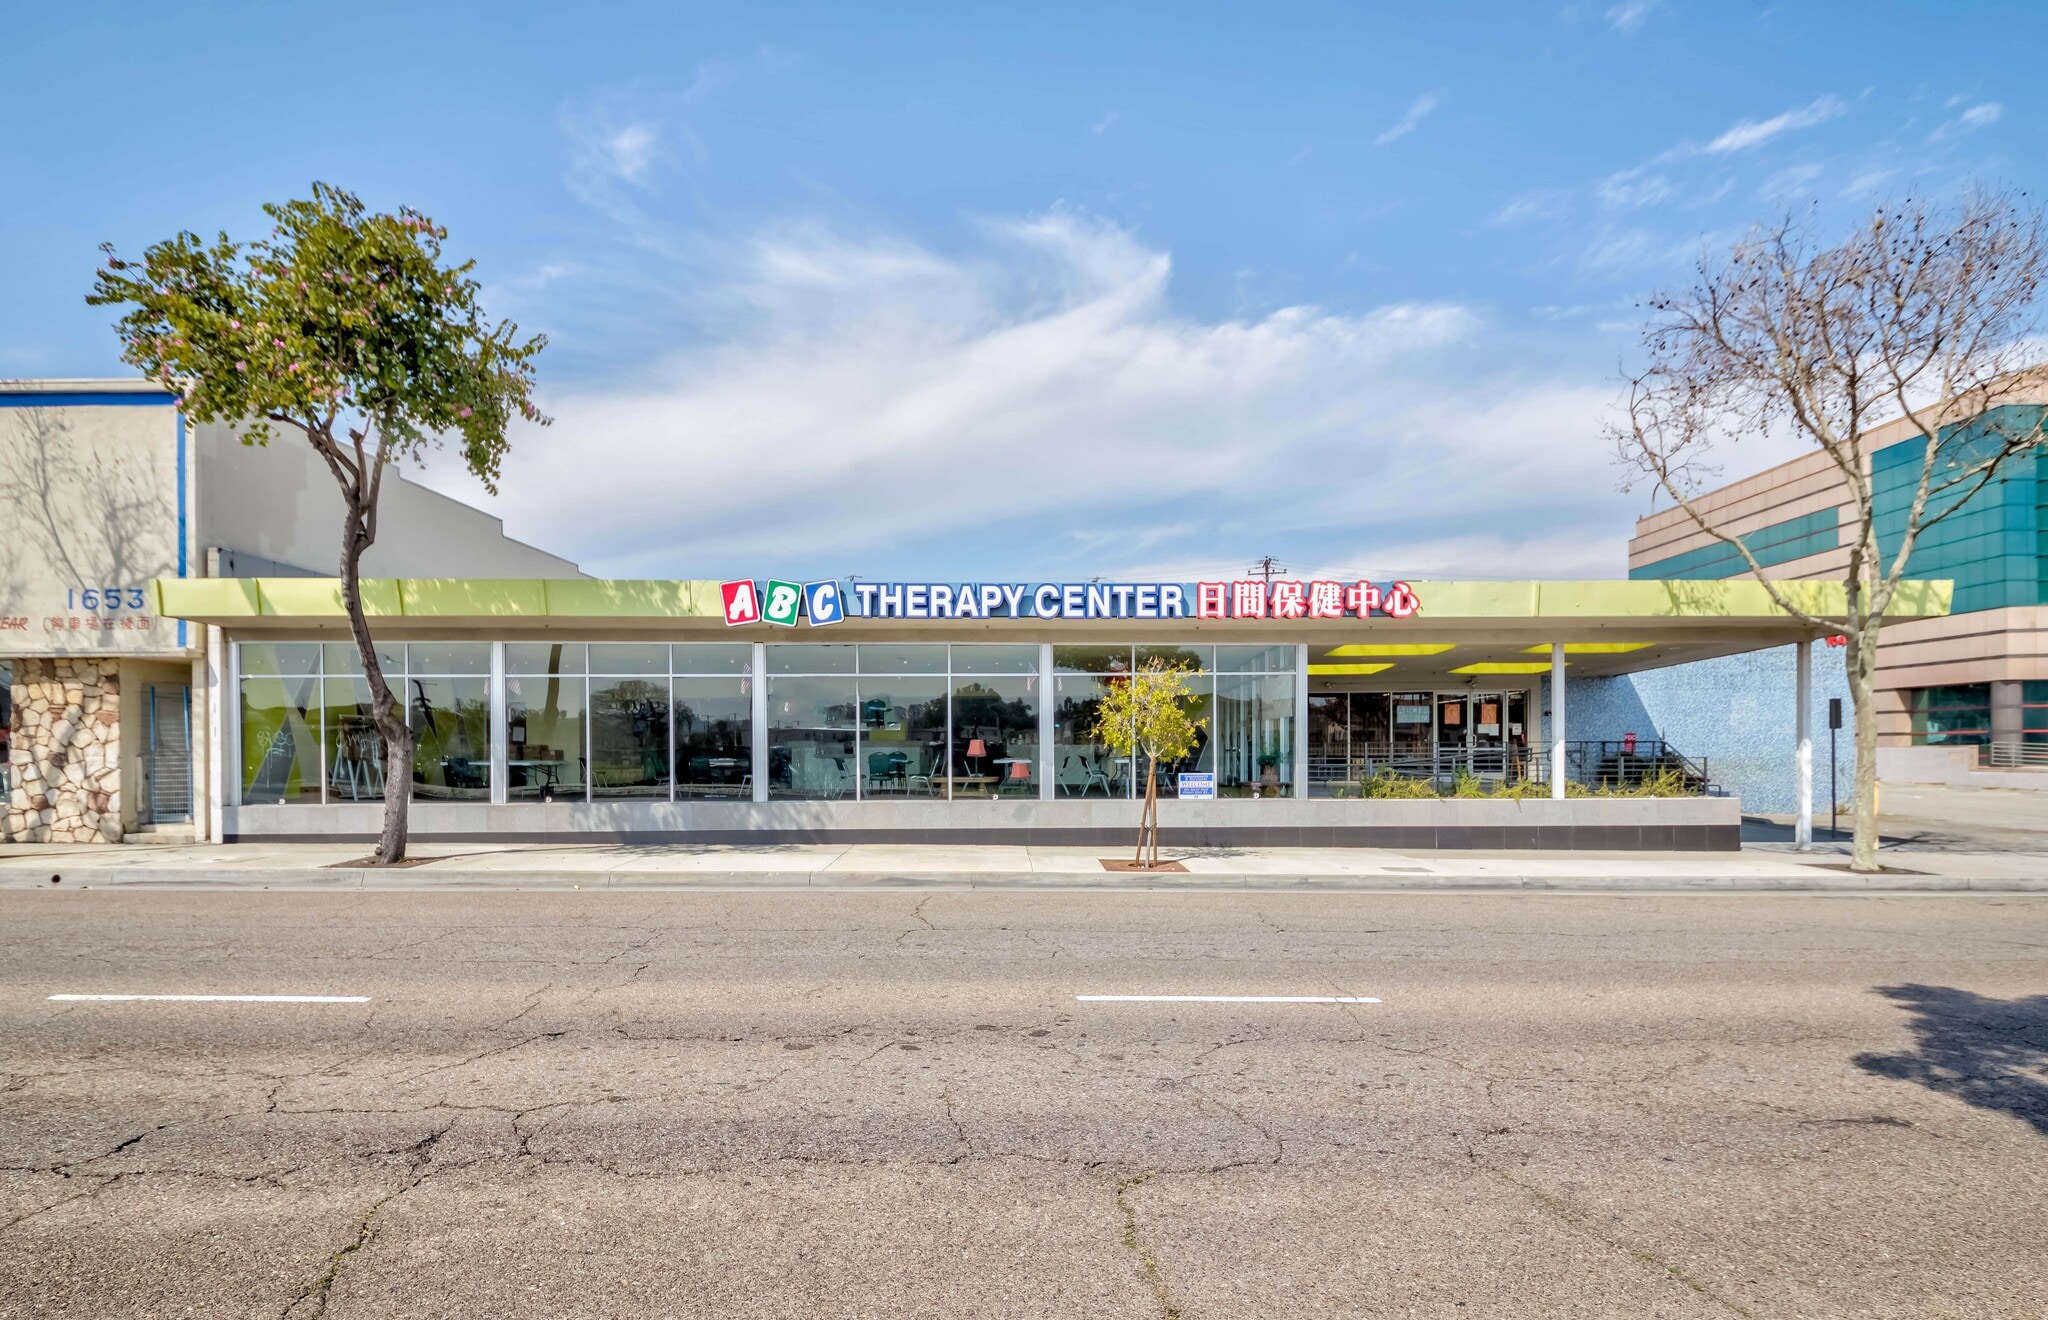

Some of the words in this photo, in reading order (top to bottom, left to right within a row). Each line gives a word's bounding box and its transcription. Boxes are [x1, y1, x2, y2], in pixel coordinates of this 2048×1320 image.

[67, 588, 144, 611] 1653
[723, 580, 840, 625] ABC
[854, 582, 1028, 619] THERAPY
[1034, 582, 1184, 620] CENTER
[1197, 580, 1421, 619] 日間保健中心
[0, 616, 29, 631] EAR
